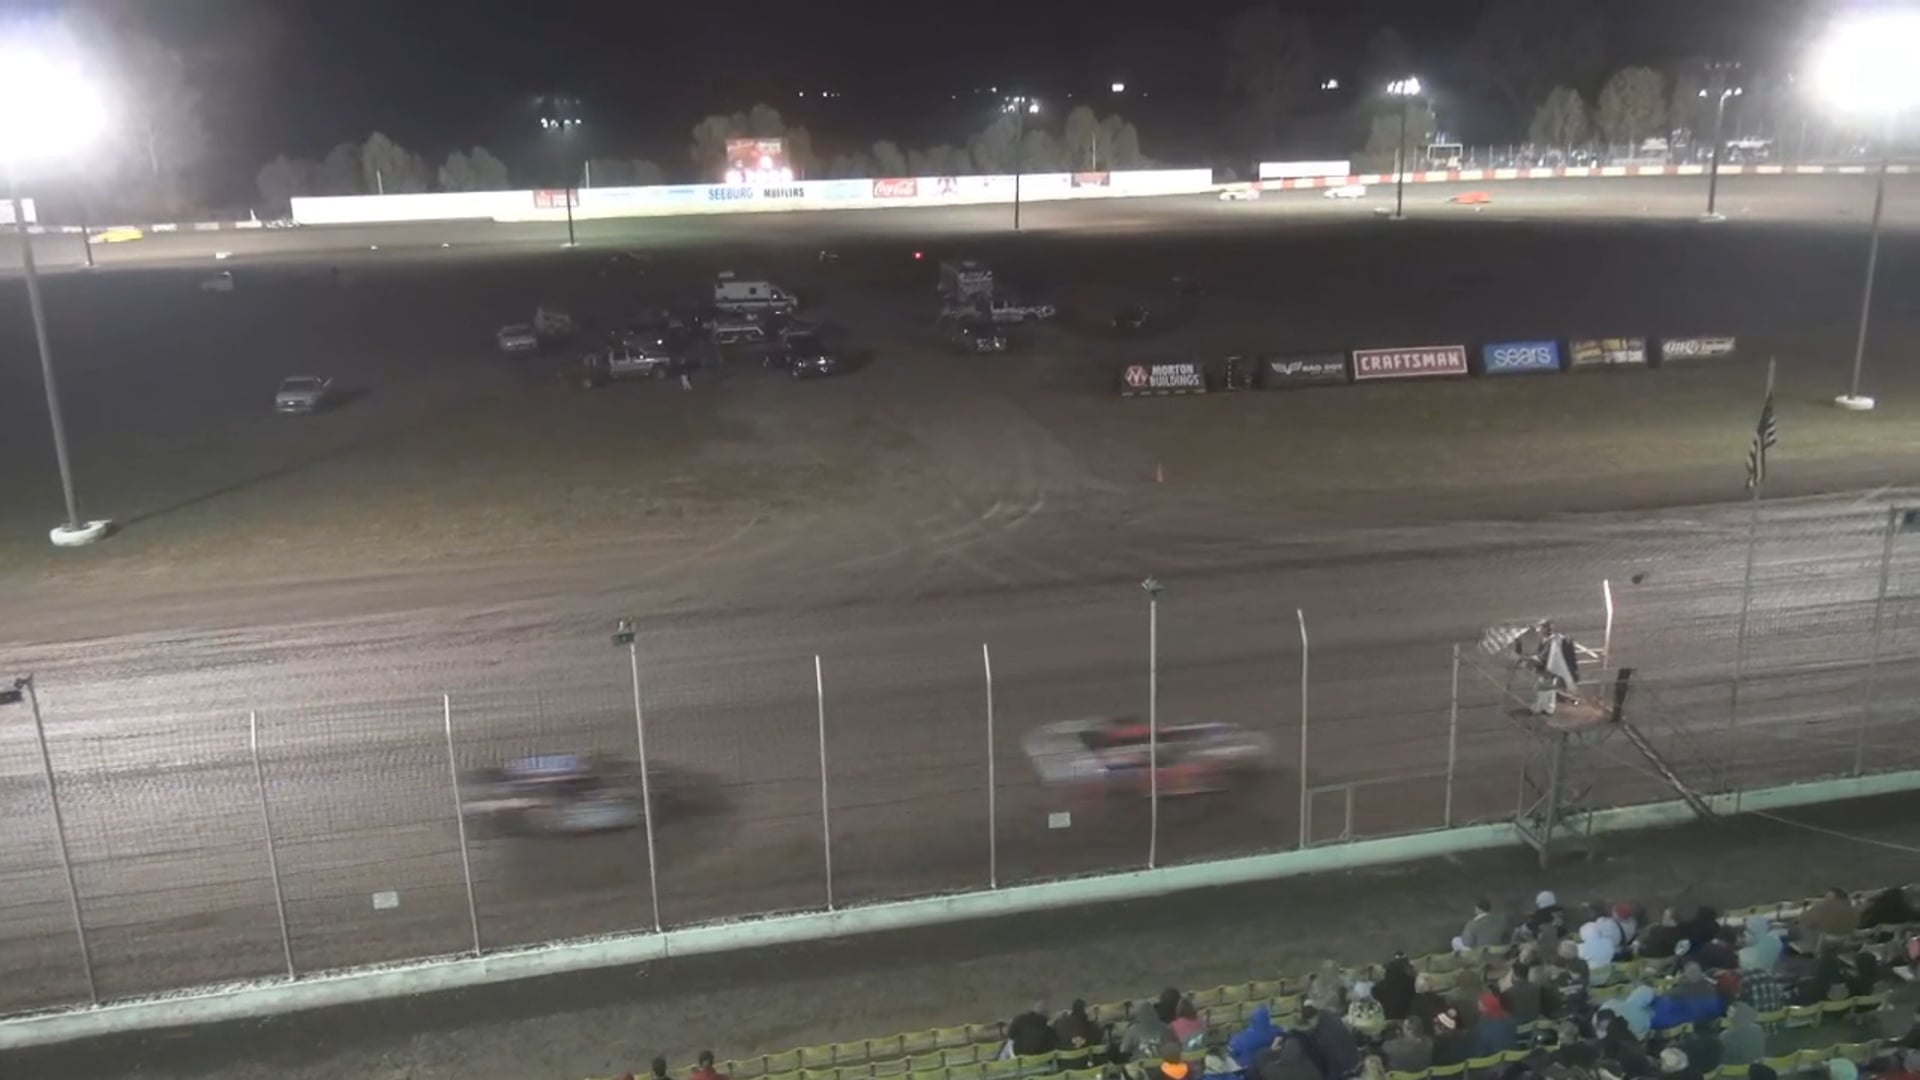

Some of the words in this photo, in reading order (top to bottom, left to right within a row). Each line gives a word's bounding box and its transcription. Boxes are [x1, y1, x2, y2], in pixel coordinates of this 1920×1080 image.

[708, 187, 753, 200] SEEBURG
[1361, 351, 1460, 371] CRAFTSMAN
[1494, 347, 1551, 367] sears
[1152, 364, 1194, 377] MORTON
[1150, 375, 1200, 387] BUILDINGS
